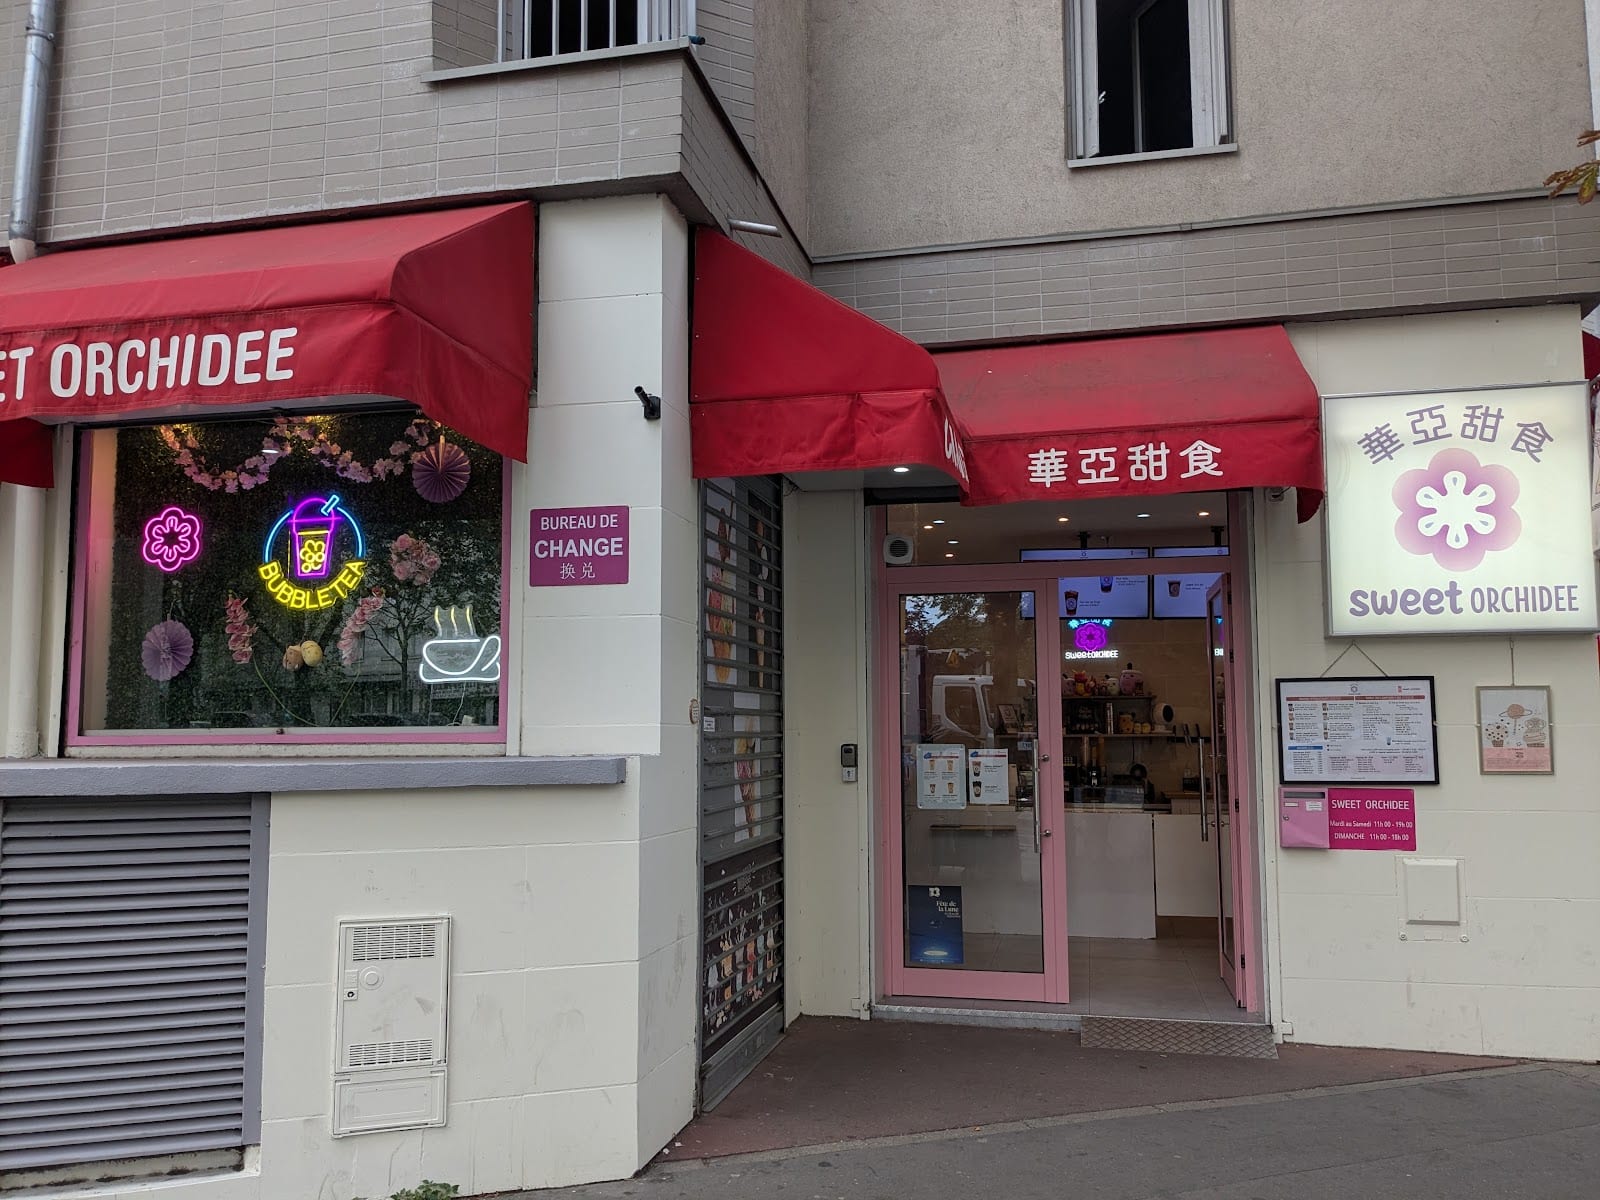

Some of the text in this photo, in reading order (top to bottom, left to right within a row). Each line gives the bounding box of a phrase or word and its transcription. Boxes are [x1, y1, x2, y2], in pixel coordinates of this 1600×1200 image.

[0, 327, 298, 401] T ORCHIDEE
[1358, 404, 1554, 465] 華亞甜食
[1027, 439, 1224, 488] 華亞甜食
[541, 514, 618, 531] BUREAU DE
[534, 537, 624, 559] CHANGE
[1349, 580, 1580, 617] sweet ORCHIDEE
[1331, 800, 1361, 809] SWEET
[1365, 801, 1410, 810] ORCHIDEE
